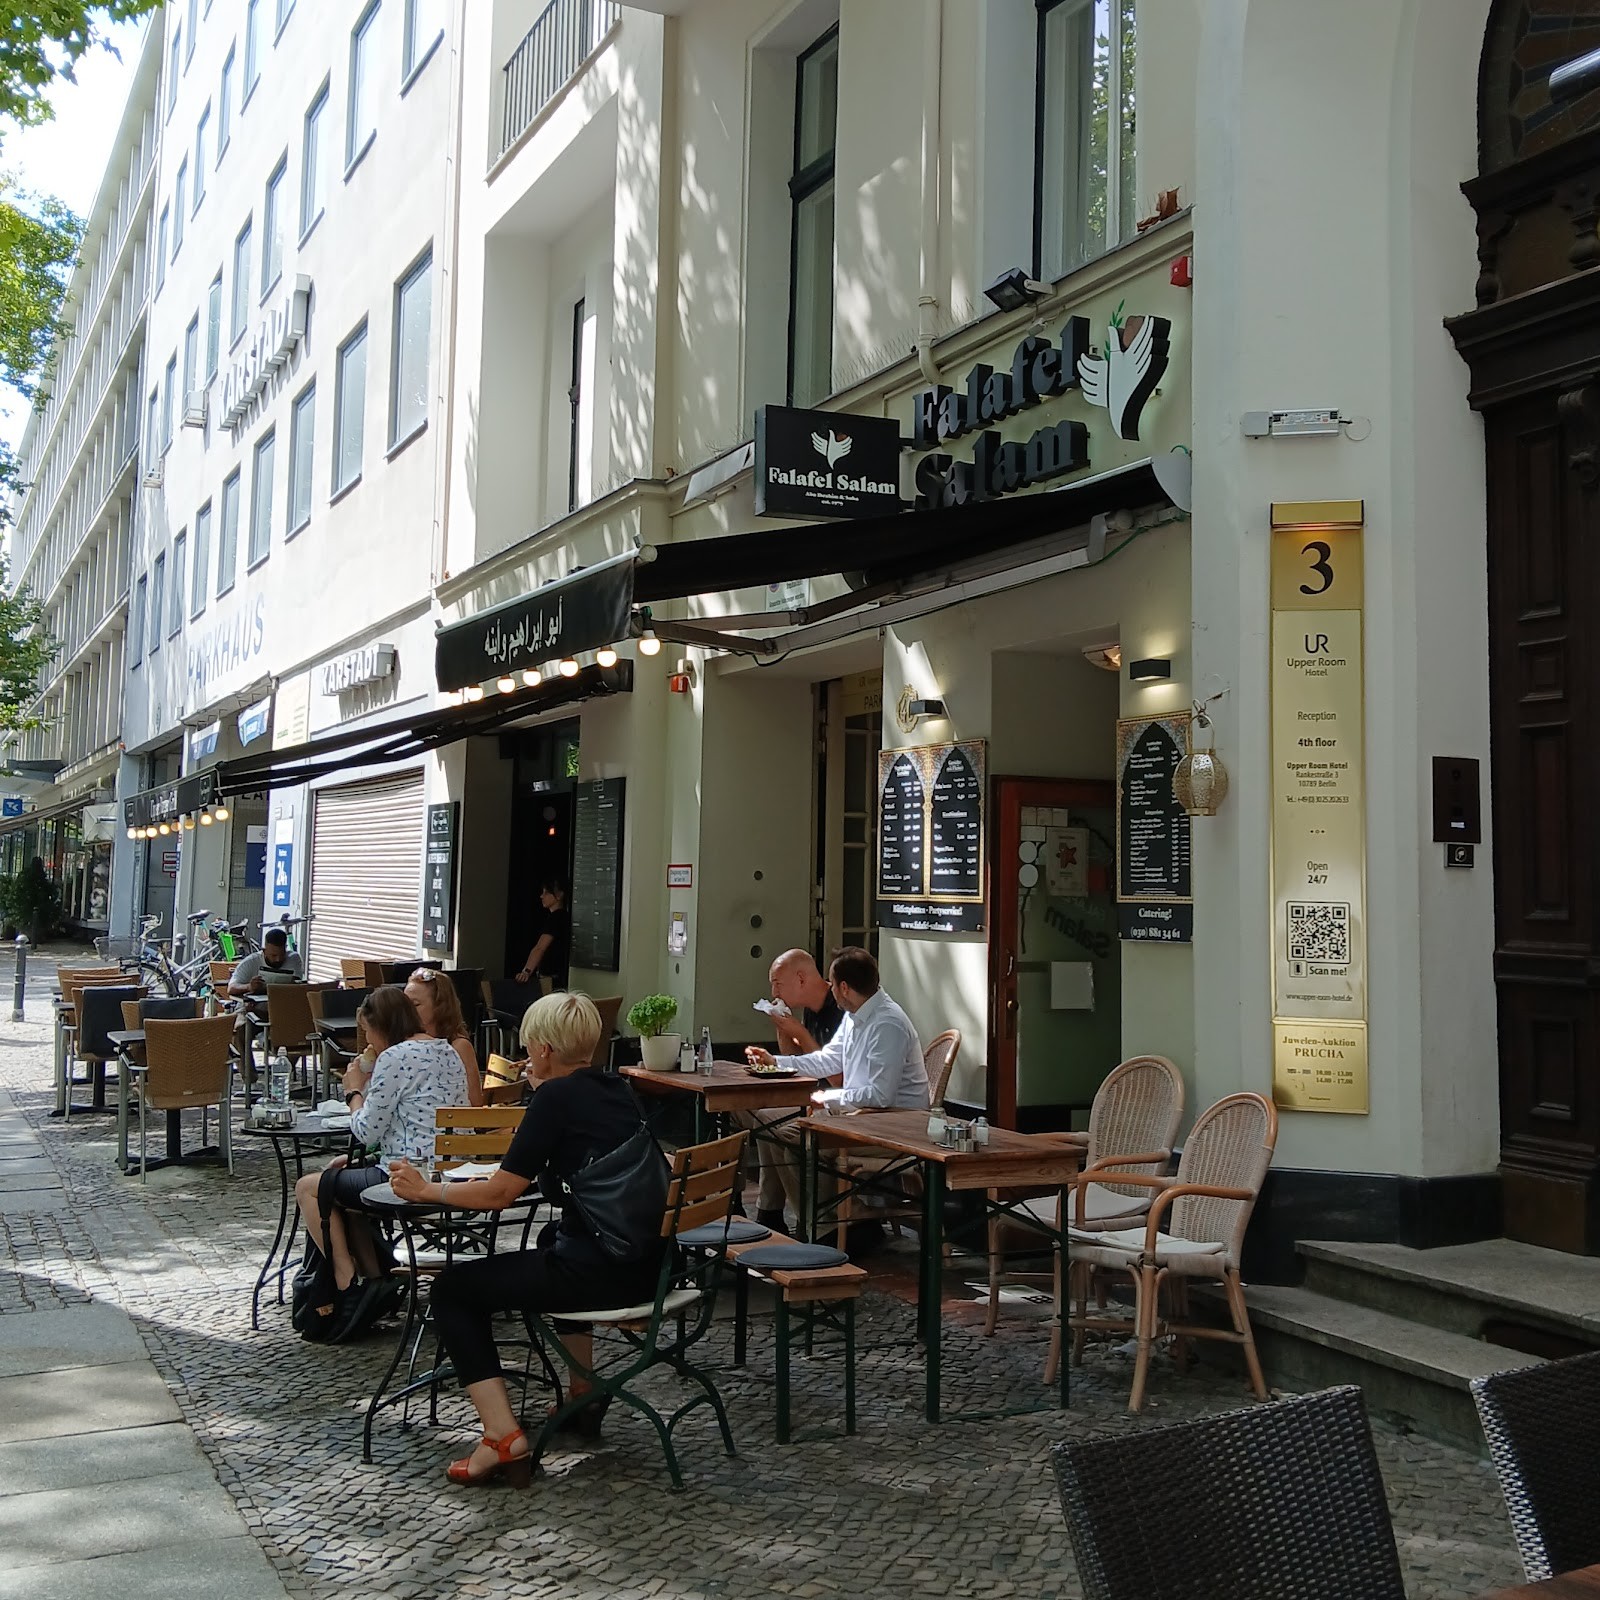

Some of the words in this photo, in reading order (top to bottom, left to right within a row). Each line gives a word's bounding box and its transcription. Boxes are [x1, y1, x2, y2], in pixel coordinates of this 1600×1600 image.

[912, 315, 1091, 452] Falafel
[915, 419, 1091, 511] Salam
[768, 465, 833, 490] Falafel
[836, 473, 896, 496] Salam
[1299, 541, 1334, 595] 3
[187, 591, 265, 696] PARKHAUS
[1305, 634, 1330, 654] UR
[1287, 657, 1316, 669] Upper
[1318, 656, 1346, 667] Room
[321, 643, 395, 697] KARSTADT
[1305, 668, 1328, 677] Hotel
[1297, 711, 1337, 722] Reception
[1298, 738, 1314, 747] 4th
[1315, 737, 1337, 747] floor
[1287, 762, 1307, 770] Upper
[1307, 861, 1328, 872] Open
[1307, 874, 1328, 885] 24/7
[1138, 907, 1172, 921] Catering!
[1130, 926, 1148, 939] (030)
[1309, 966, 1330, 976] Scan
[1331, 966, 1348, 976] me!
[1282, 1036, 1356, 1047] Juwelen-Auktion
[1294, 1048, 1345, 1059] PRUCHA
